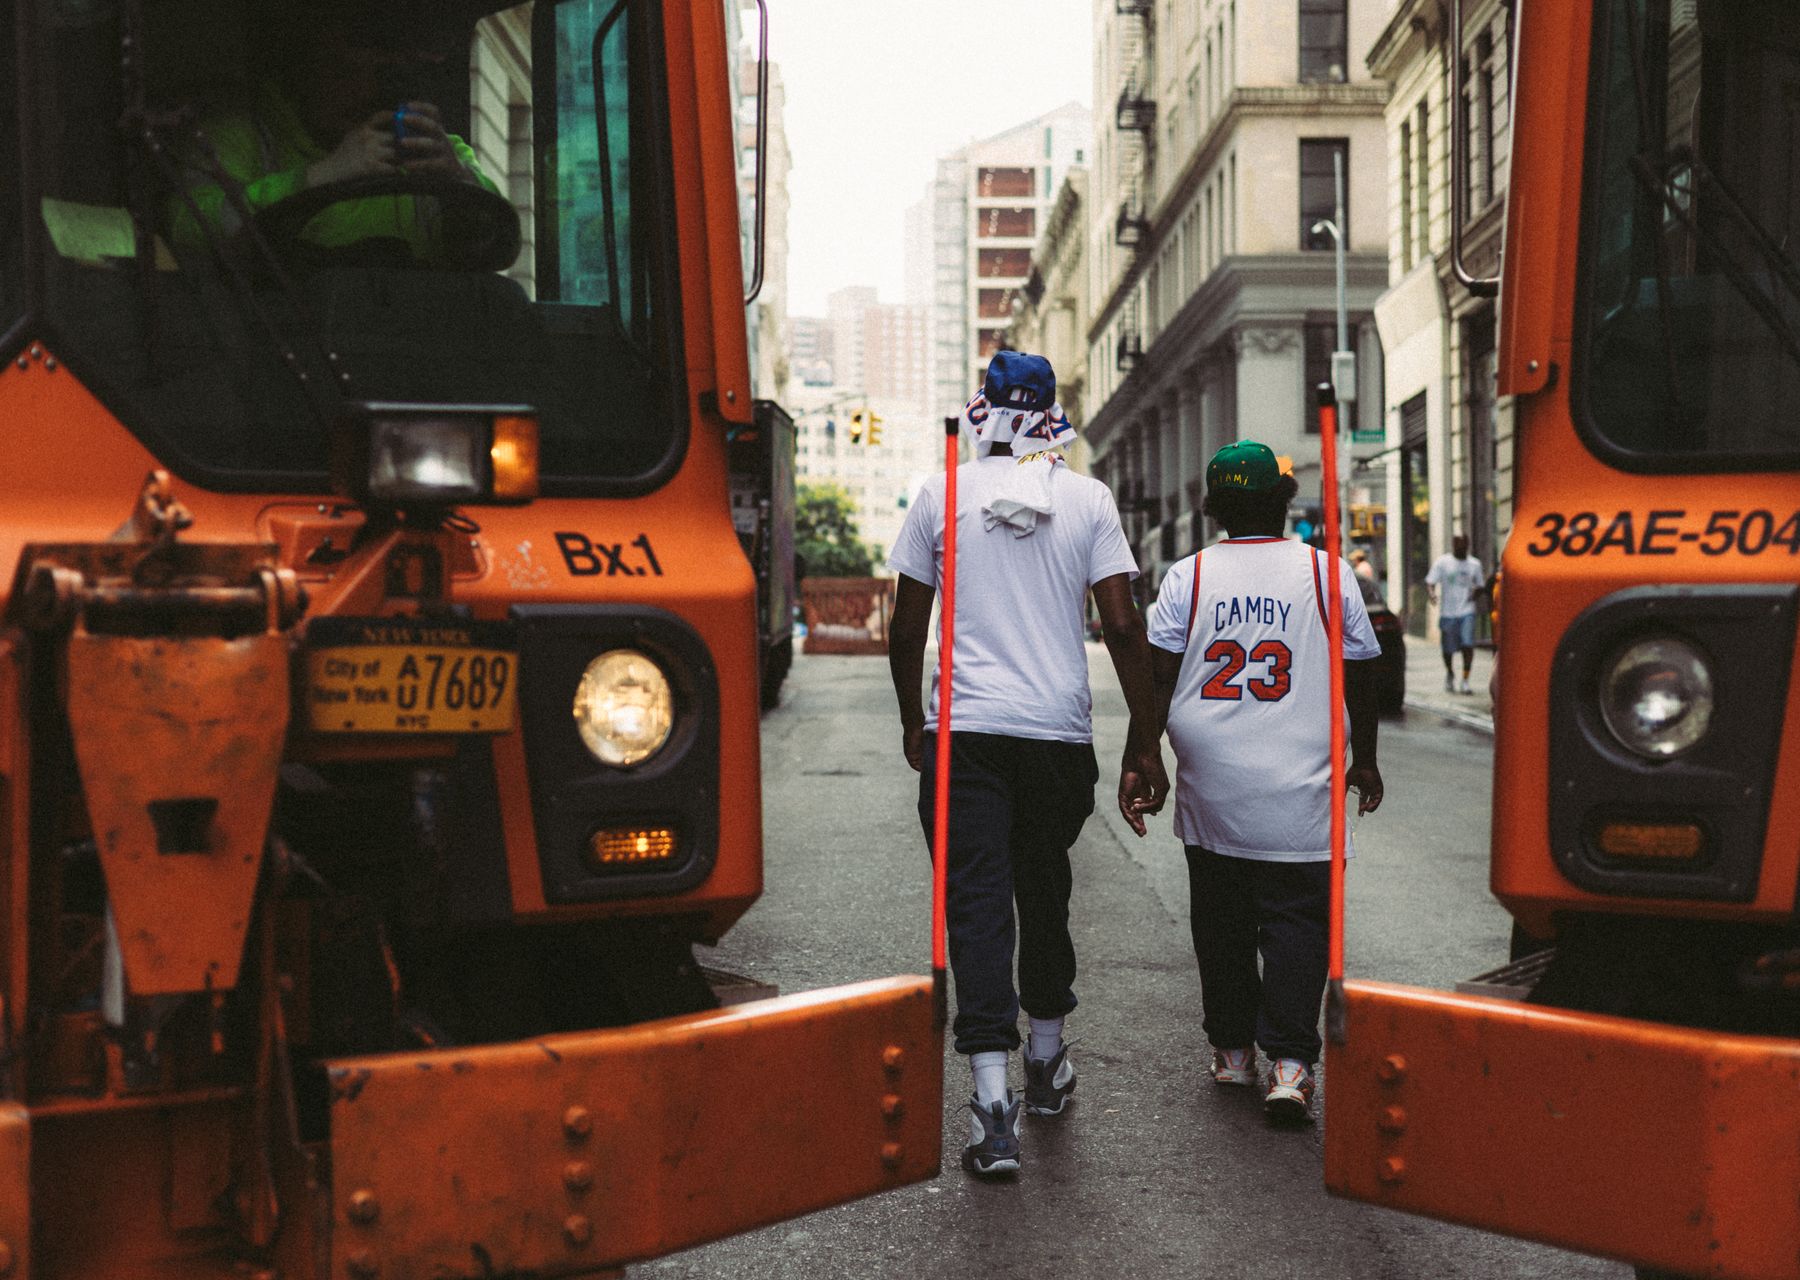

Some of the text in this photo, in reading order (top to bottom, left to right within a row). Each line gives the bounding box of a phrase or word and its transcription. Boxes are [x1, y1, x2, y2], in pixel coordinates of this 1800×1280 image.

[554, 532, 663, 576] Bx.1
[1214, 596, 1292, 633] CAMBY
[362, 660, 381, 677] of
[1200, 640, 1292, 702] 23
